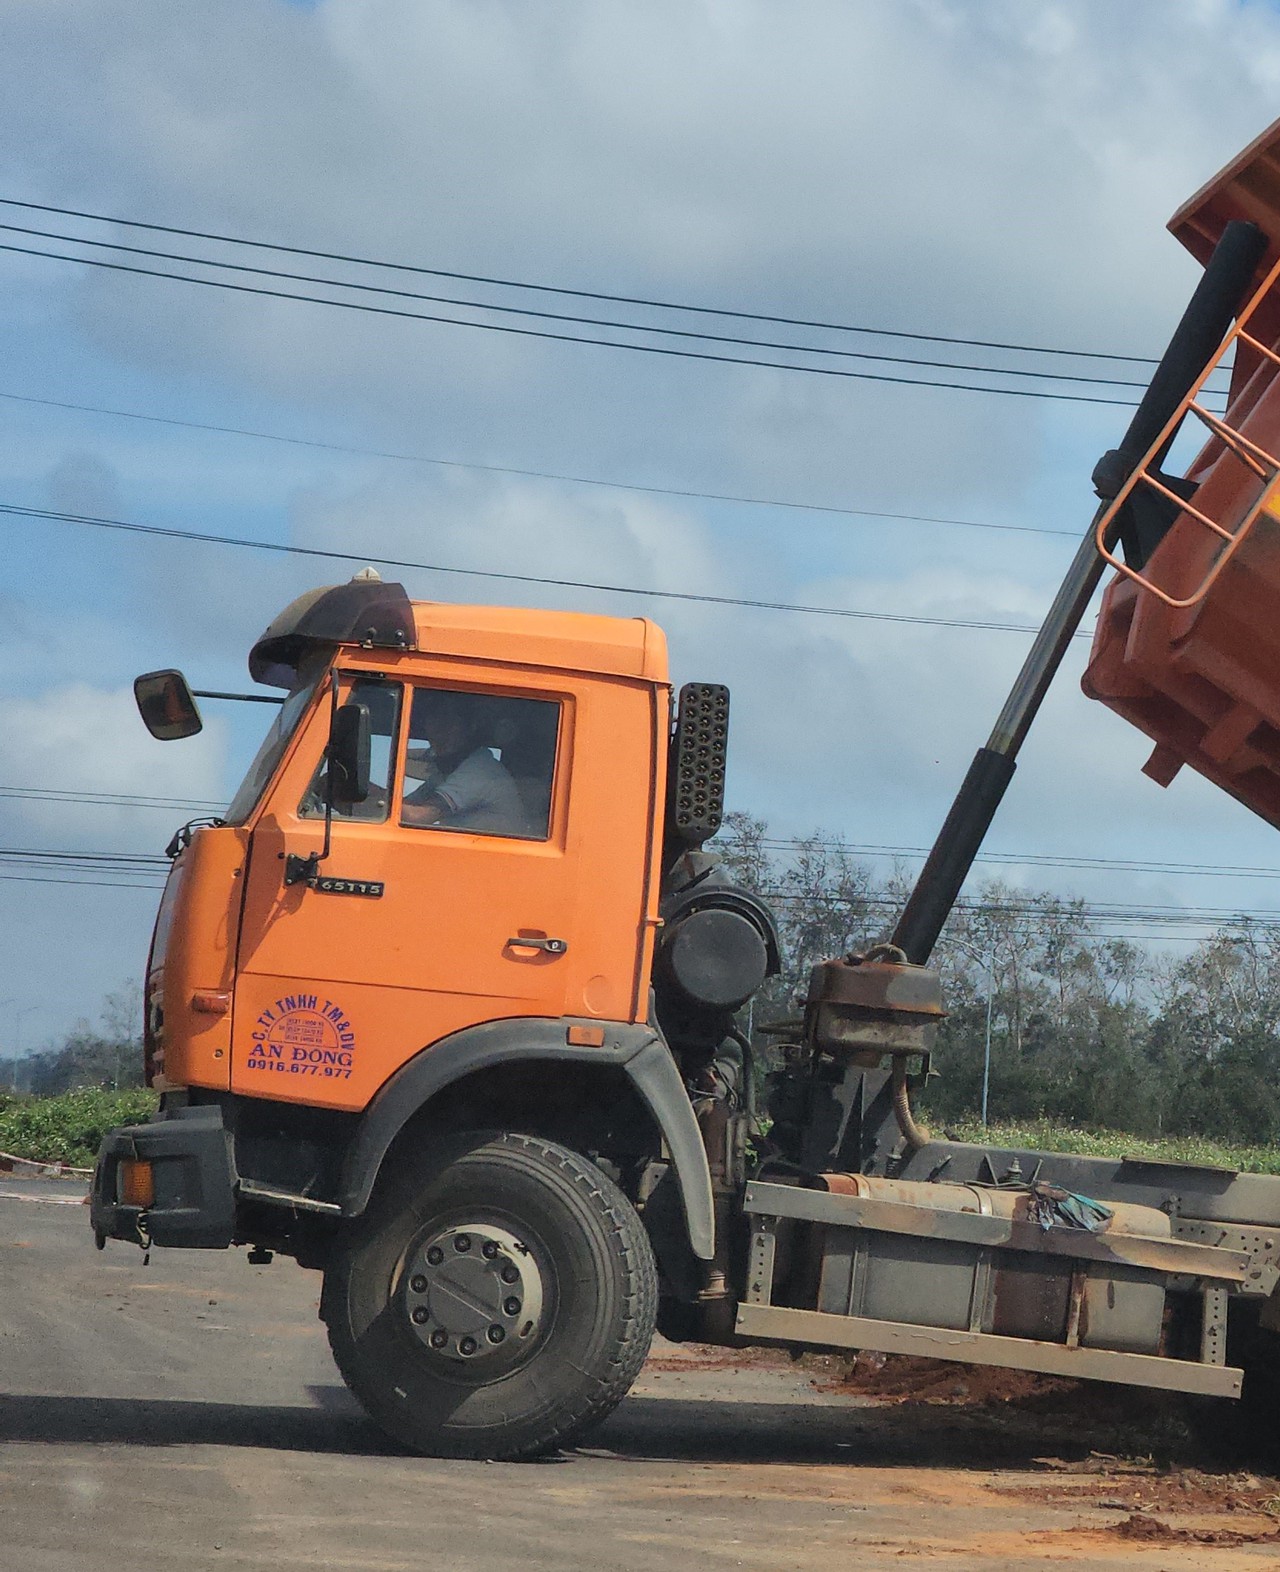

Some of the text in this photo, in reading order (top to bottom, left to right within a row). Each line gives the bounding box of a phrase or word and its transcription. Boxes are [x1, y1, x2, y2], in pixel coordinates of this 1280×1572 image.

[321, 880, 381, 894] 65115
[275, 994, 318, 1013] TNHH
[249, 1043, 284, 1059] AN
[247, 1058, 352, 1079] 0916.677.977
